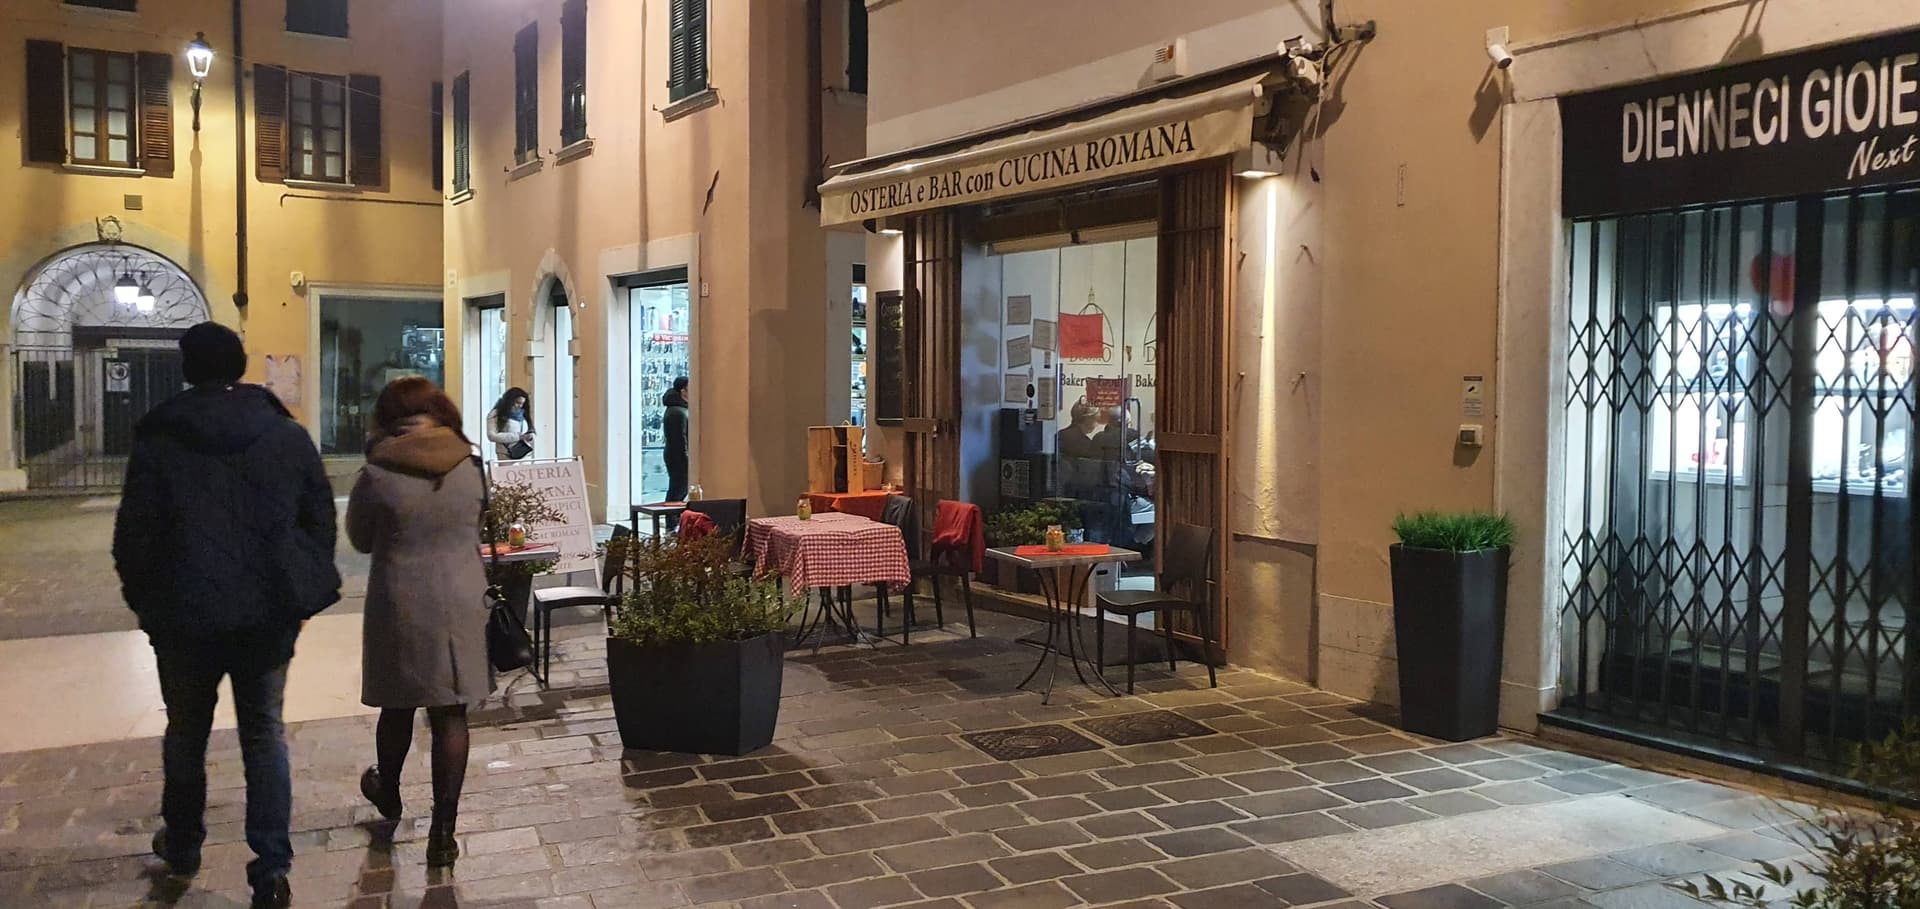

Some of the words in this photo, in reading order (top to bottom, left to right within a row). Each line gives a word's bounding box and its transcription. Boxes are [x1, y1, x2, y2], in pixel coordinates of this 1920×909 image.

[1622, 75, 1790, 164] DIENNECI
[1801, 53, 1920, 139] GIOIE
[850, 181, 913, 215] OSTERIA
[917, 184, 925, 203] e
[928, 170, 963, 201] BAR
[966, 171, 993, 194] con
[1000, 145, 1080, 188] CUCINA
[1085, 119, 1195, 172] ROMANA
[1847, 134, 1920, 180] Next
[506, 466, 571, 481] OSTERIA
